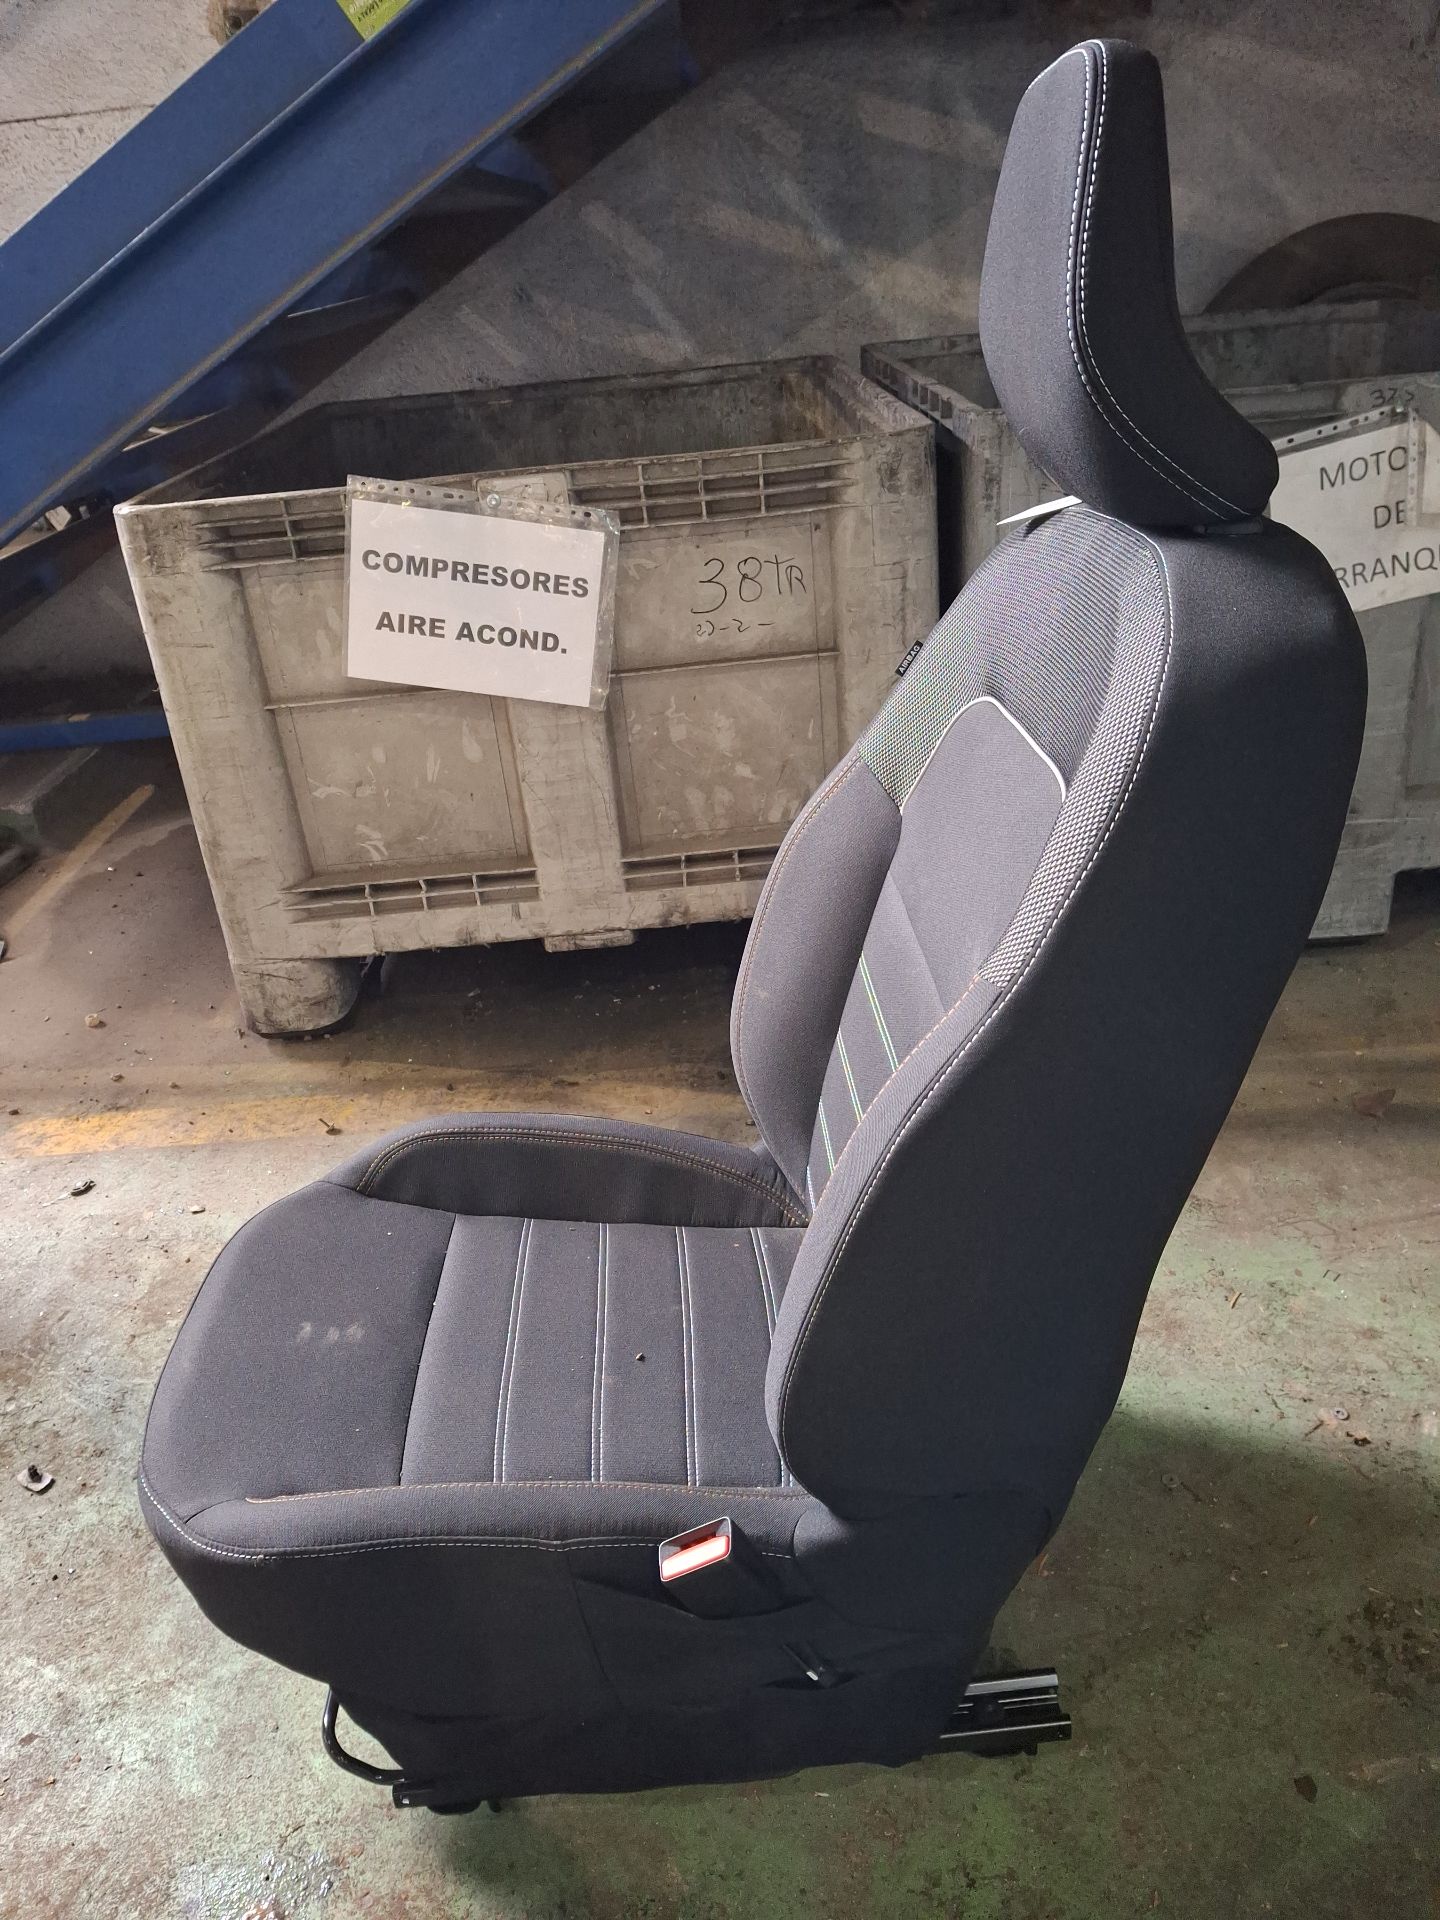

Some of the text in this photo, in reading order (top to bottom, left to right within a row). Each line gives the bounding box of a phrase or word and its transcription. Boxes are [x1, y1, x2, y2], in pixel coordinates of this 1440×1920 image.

[1319, 446, 1409, 491] MOTO
[1373, 500, 1407, 530] DE
[361, 549, 589, 598] COMPRESORES
[1334, 544, 1440, 589] RRANQ
[375, 611, 568, 655] AIRE ACOND.
[898, 644, 921, 674] AIRBAG
